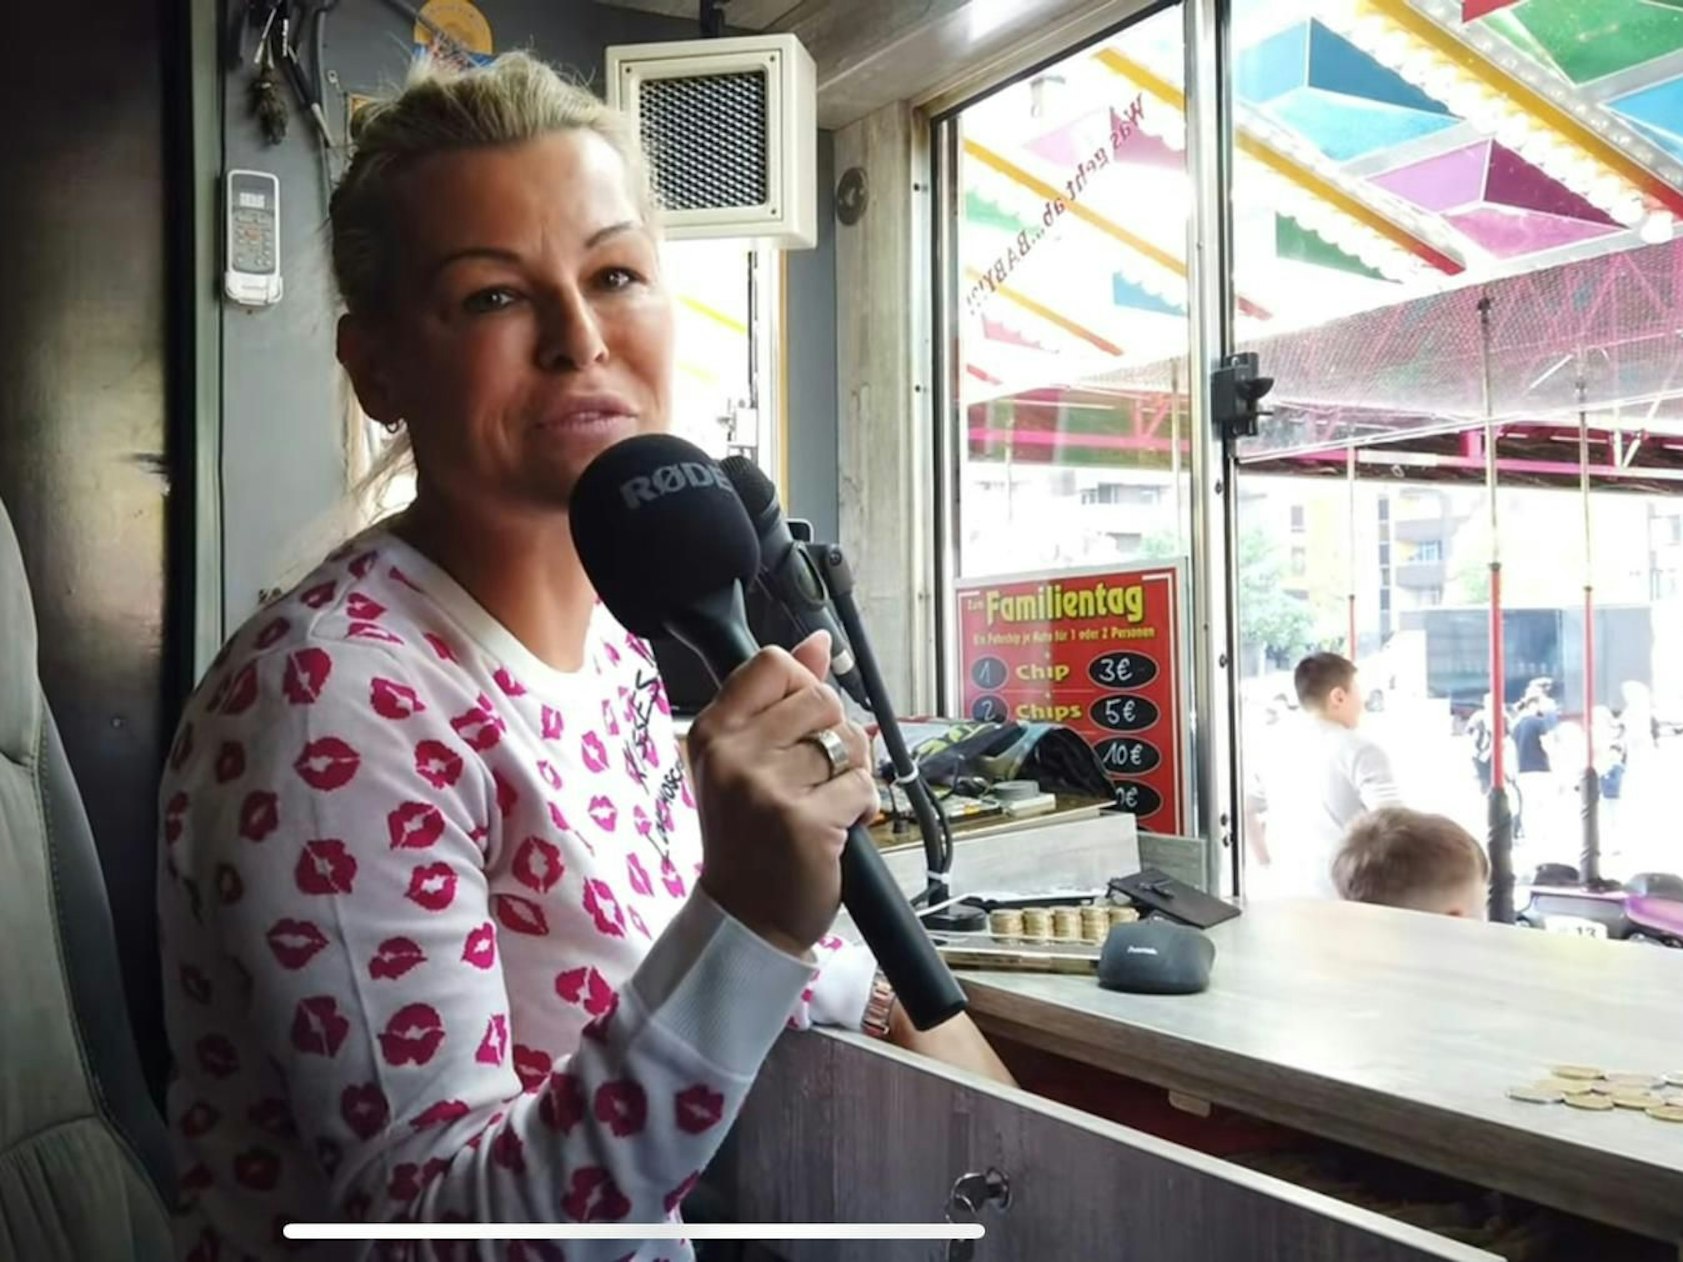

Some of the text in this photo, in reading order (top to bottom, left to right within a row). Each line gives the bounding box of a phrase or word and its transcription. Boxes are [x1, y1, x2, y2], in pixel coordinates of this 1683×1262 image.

[619, 461, 734, 510] RØDE
[986, 583, 1144, 625] Familientag
[1054, 629, 1068, 642] für
[1078, 628, 1099, 641] oder
[1111, 625, 1156, 639] Personen
[979, 657, 1133, 684] 1 Chip 3€
[981, 699, 1136, 724] 2 Chips 5€
